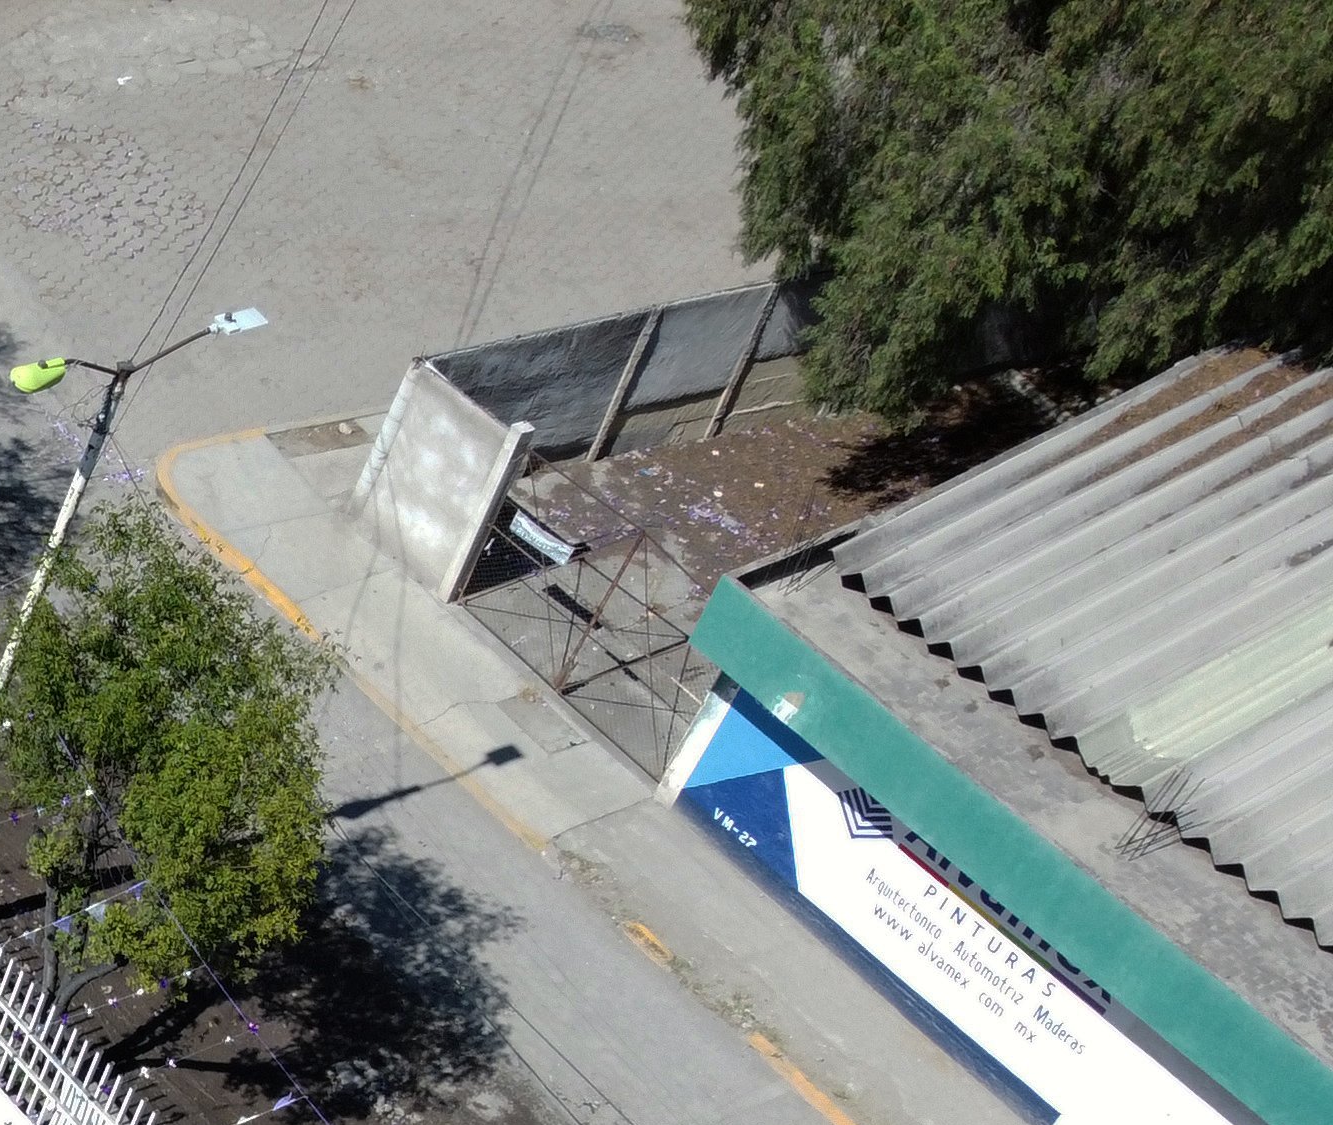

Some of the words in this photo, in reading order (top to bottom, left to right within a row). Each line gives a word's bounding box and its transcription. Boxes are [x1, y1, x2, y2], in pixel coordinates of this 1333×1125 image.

[713, 807, 758, 848] VM-27
[923, 884, 1057, 998] PINTURAS
[952, 940, 1025, 1006] Automotriz
[1033, 1004, 1086, 1056] Maderas
